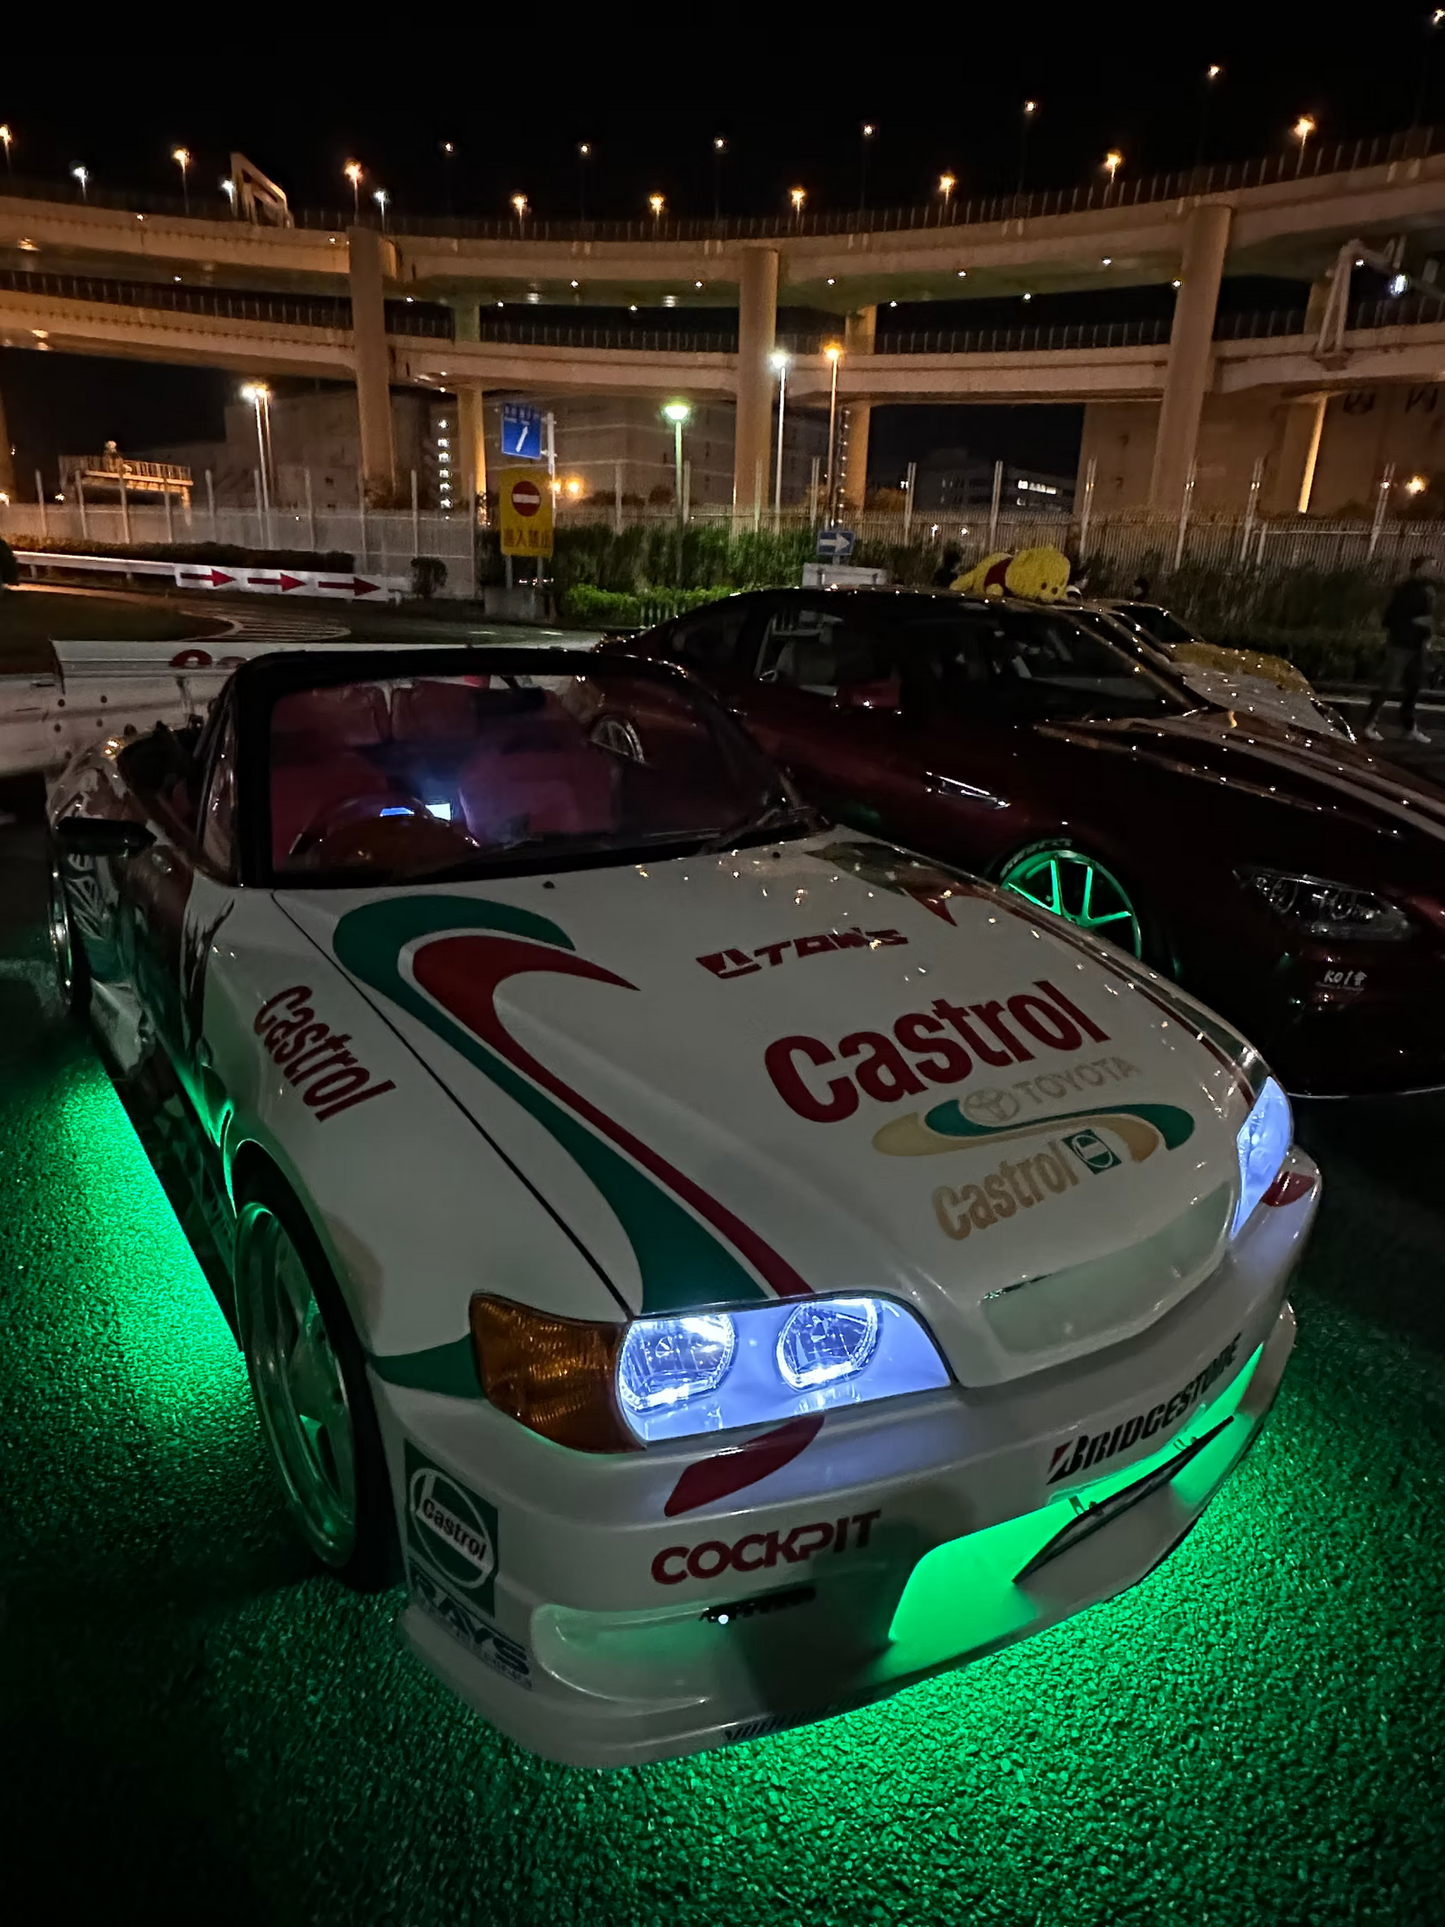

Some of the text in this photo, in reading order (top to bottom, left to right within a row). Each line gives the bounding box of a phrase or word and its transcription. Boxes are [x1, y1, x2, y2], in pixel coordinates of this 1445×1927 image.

[254, 985, 397, 1123] Castrol
[764, 980, 1111, 1123] Castrol
[1012, 1056, 1142, 1105] TOYOTA
[931, 1140, 1080, 1241] Castrol
[1046, 1331, 1243, 1485] BRIDGESTONE
[422, 1497, 487, 1562] Castrol
[651, 1508, 881, 1585] COCKPIT
